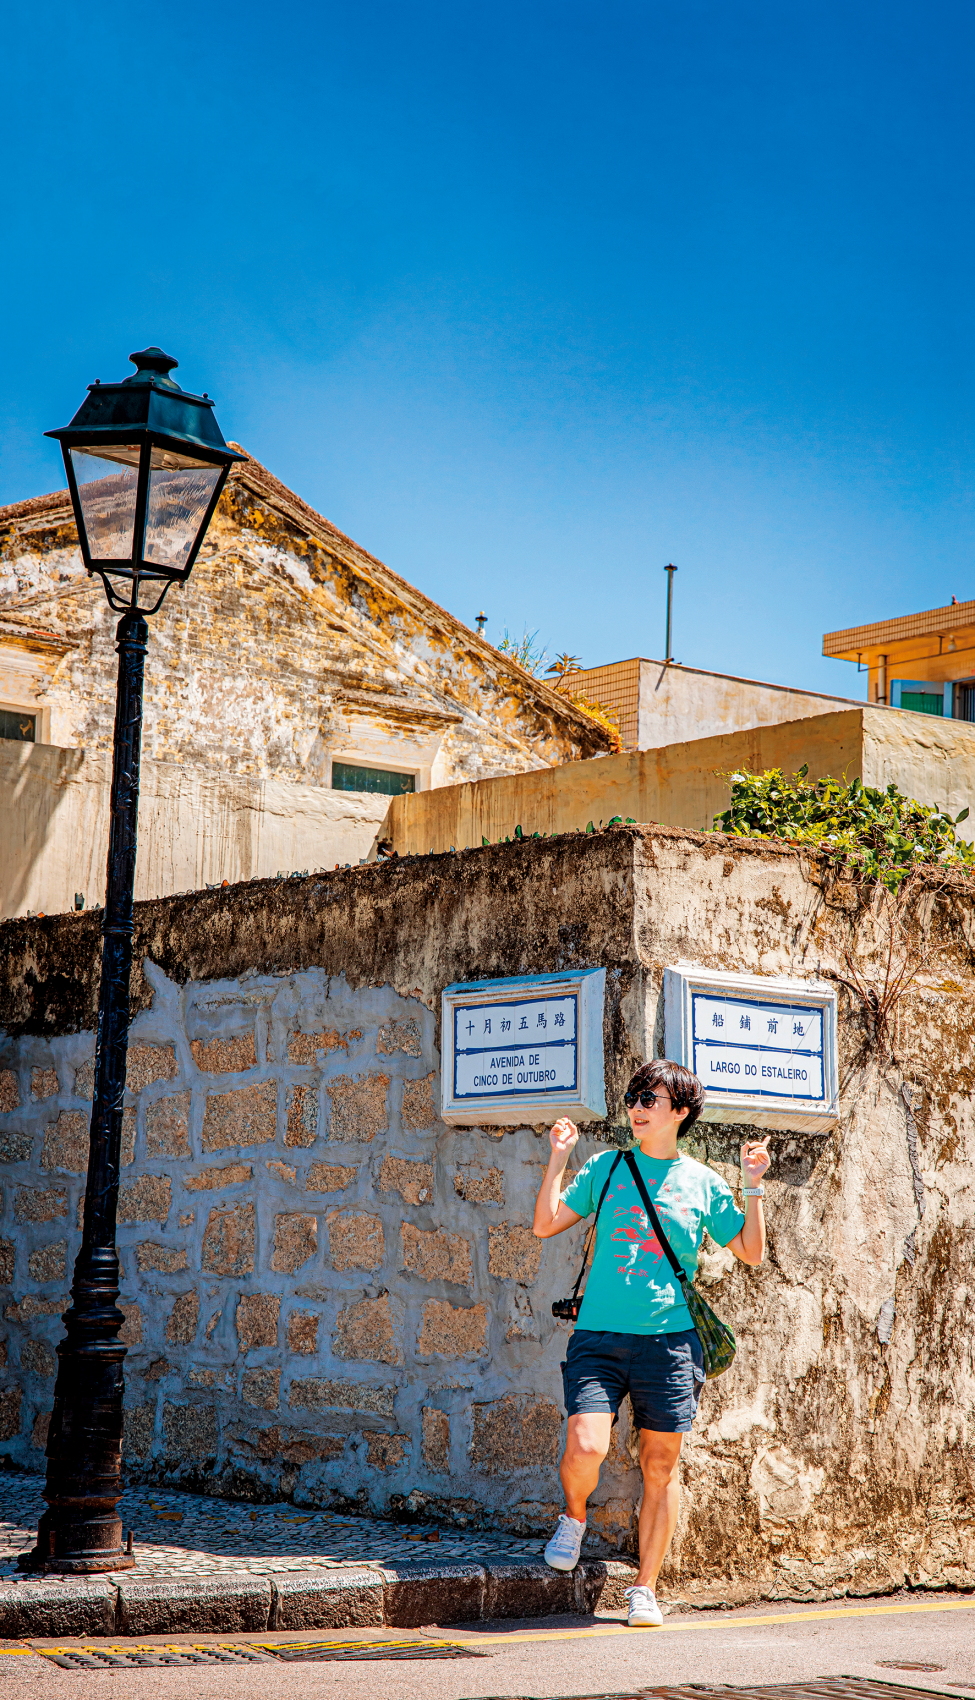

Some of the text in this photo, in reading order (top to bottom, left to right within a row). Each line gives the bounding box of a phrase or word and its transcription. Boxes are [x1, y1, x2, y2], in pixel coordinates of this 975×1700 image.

[465, 1011, 566, 1036] 十月初五馬路
[712, 1012, 805, 1037] 船鋪前地
[490, 1054, 540, 1069] AVENIDA DE
[710, 1060, 808, 1081] LARGO DO ESTALEIRO
[473, 1069, 556, 1087] CINCO DE OUTUBRO
